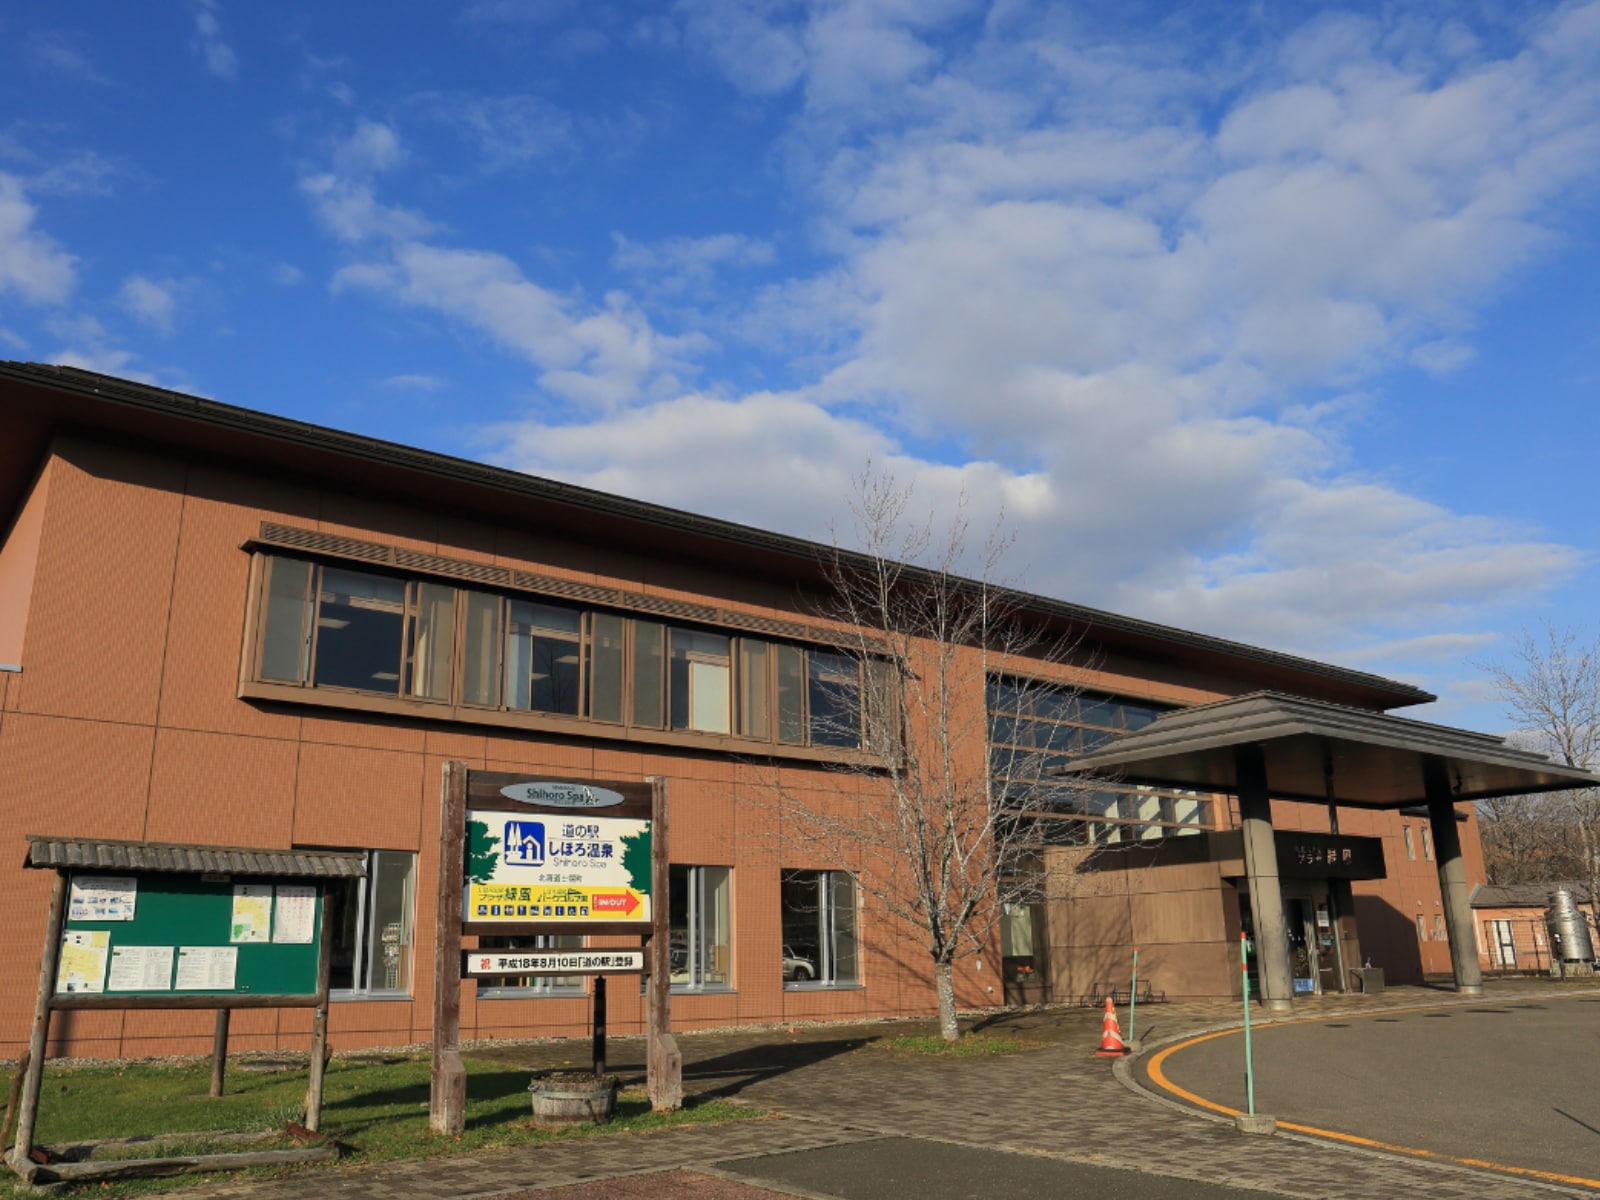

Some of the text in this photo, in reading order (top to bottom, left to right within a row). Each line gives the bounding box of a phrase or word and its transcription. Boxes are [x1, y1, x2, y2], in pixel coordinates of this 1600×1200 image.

[527, 788, 584, 802] Shihoro Spa
[563, 824, 599, 838] 道の駅
[549, 841, 613, 858] しほろ温泉
[553, 858, 607, 869] Shihoro Spa
[480, 958, 491, 970] 祝
